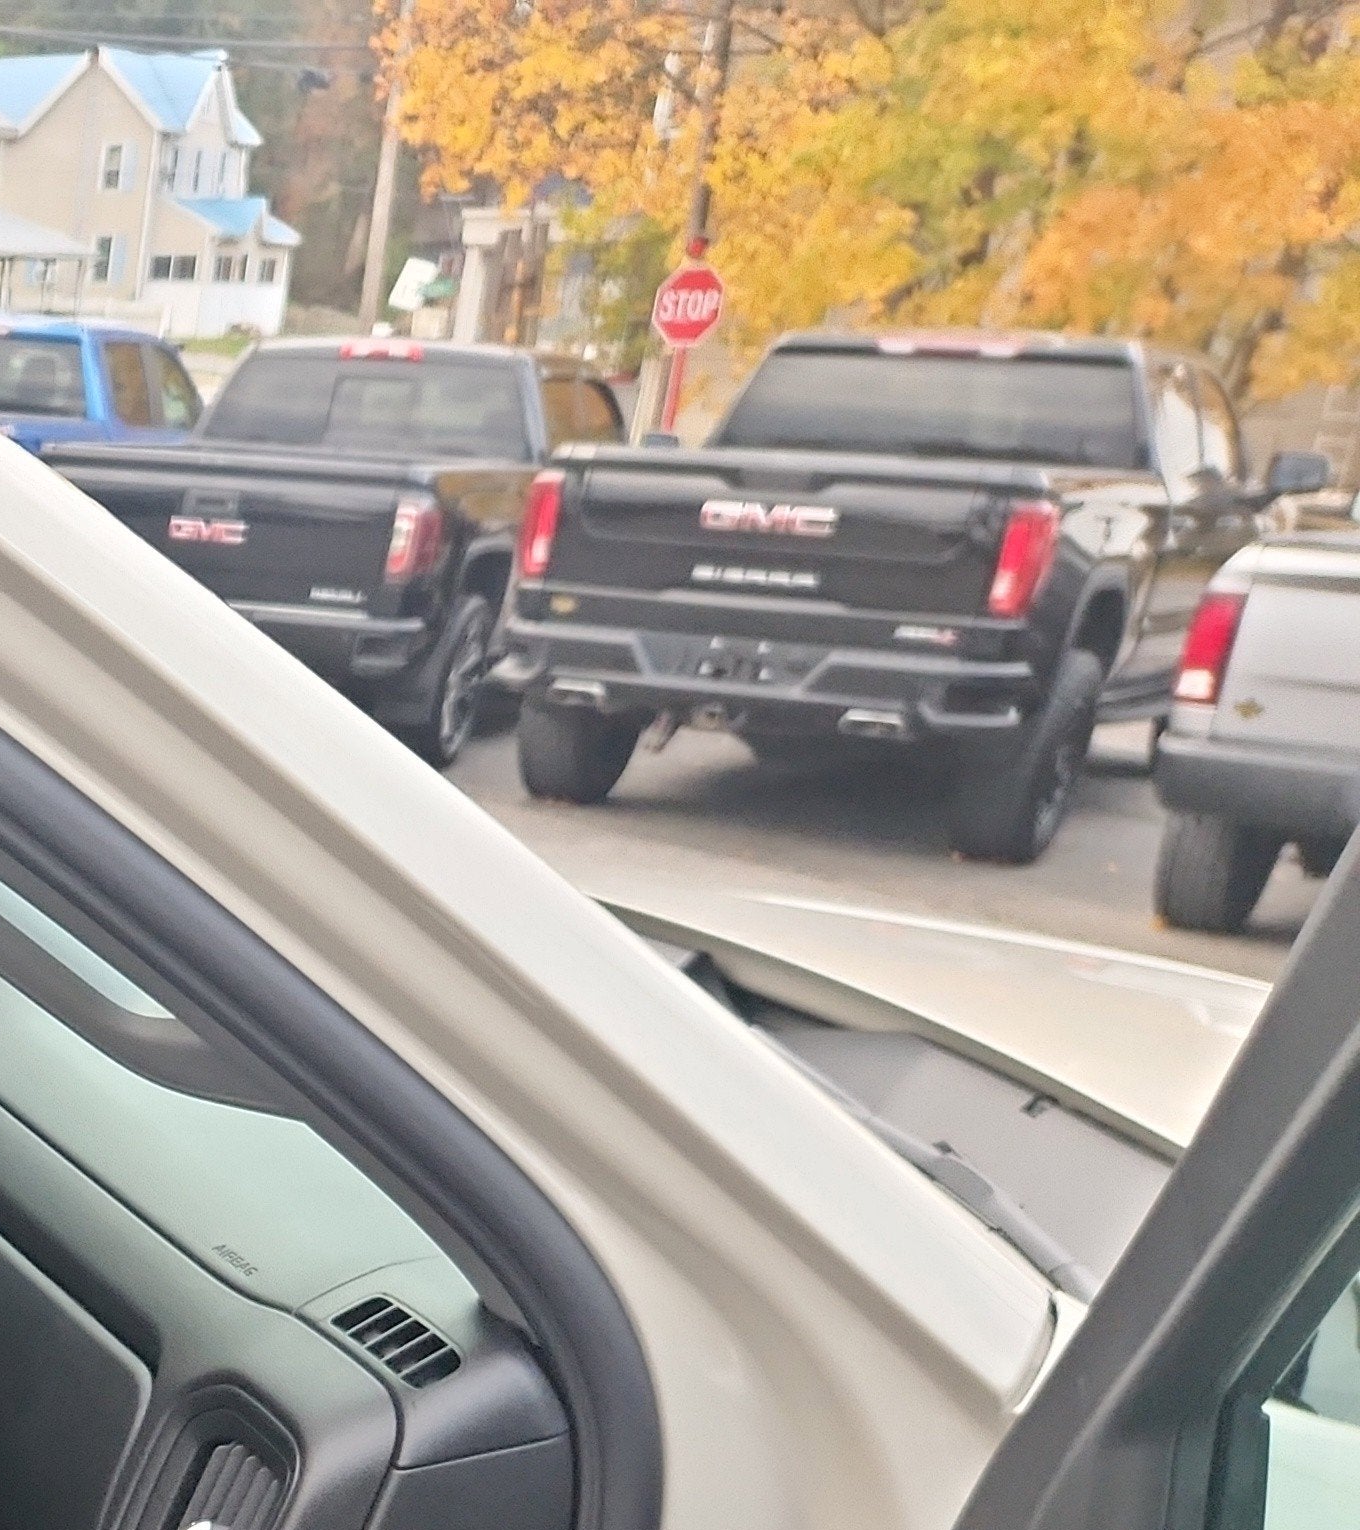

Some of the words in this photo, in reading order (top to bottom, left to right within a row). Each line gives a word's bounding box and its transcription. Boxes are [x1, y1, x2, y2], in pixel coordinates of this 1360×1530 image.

[660, 288, 720, 321] STOP
[168, 515, 249, 545] GMC
[700, 500, 839, 538] GMC
